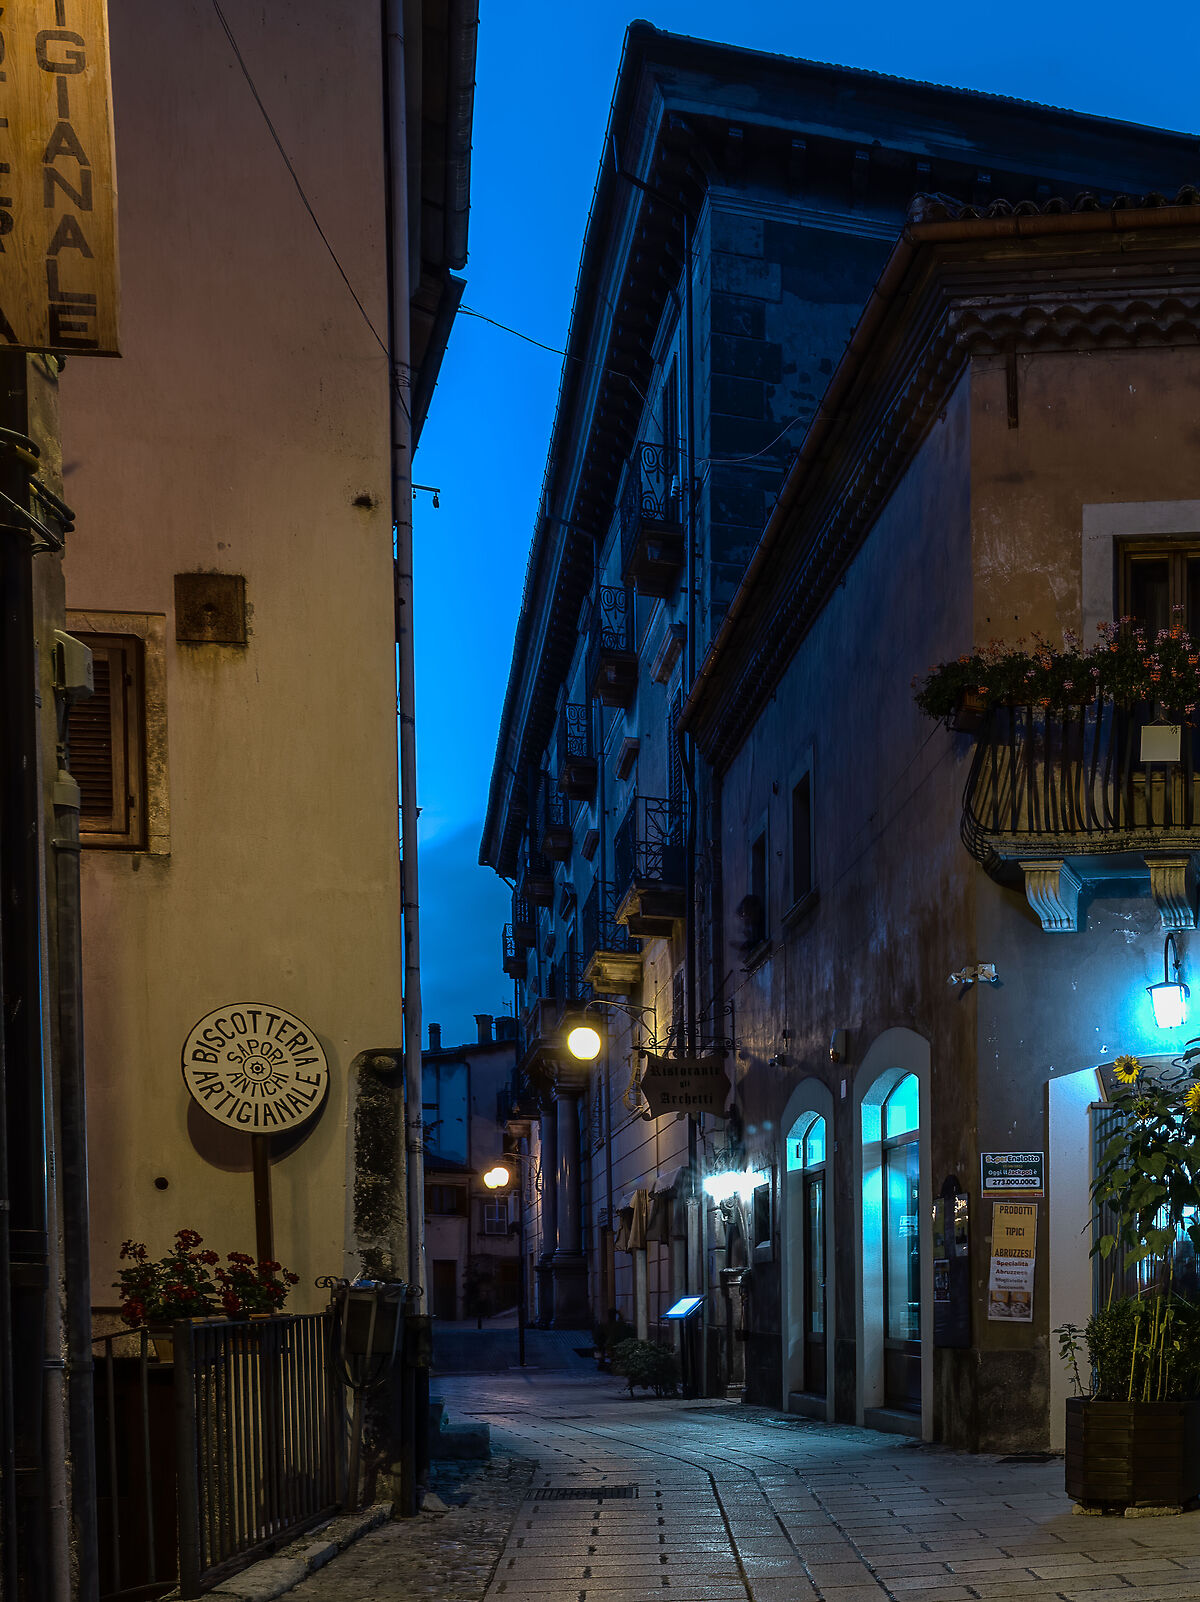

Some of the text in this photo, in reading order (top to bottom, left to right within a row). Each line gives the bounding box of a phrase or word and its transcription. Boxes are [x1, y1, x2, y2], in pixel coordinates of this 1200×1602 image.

[191, 1010, 319, 1067] BISCOTTERIA
[226, 1039, 289, 1065] SAPORI
[226, 1071, 290, 1098] ANTICHI
[192, 1071, 321, 1127] ARTIGIANALE
[999, 1205, 1033, 1216] PRODOTTI
[1005, 1226, 1025, 1237] TIPICI
[994, 1248, 1032, 1259] ABRUZZESI
